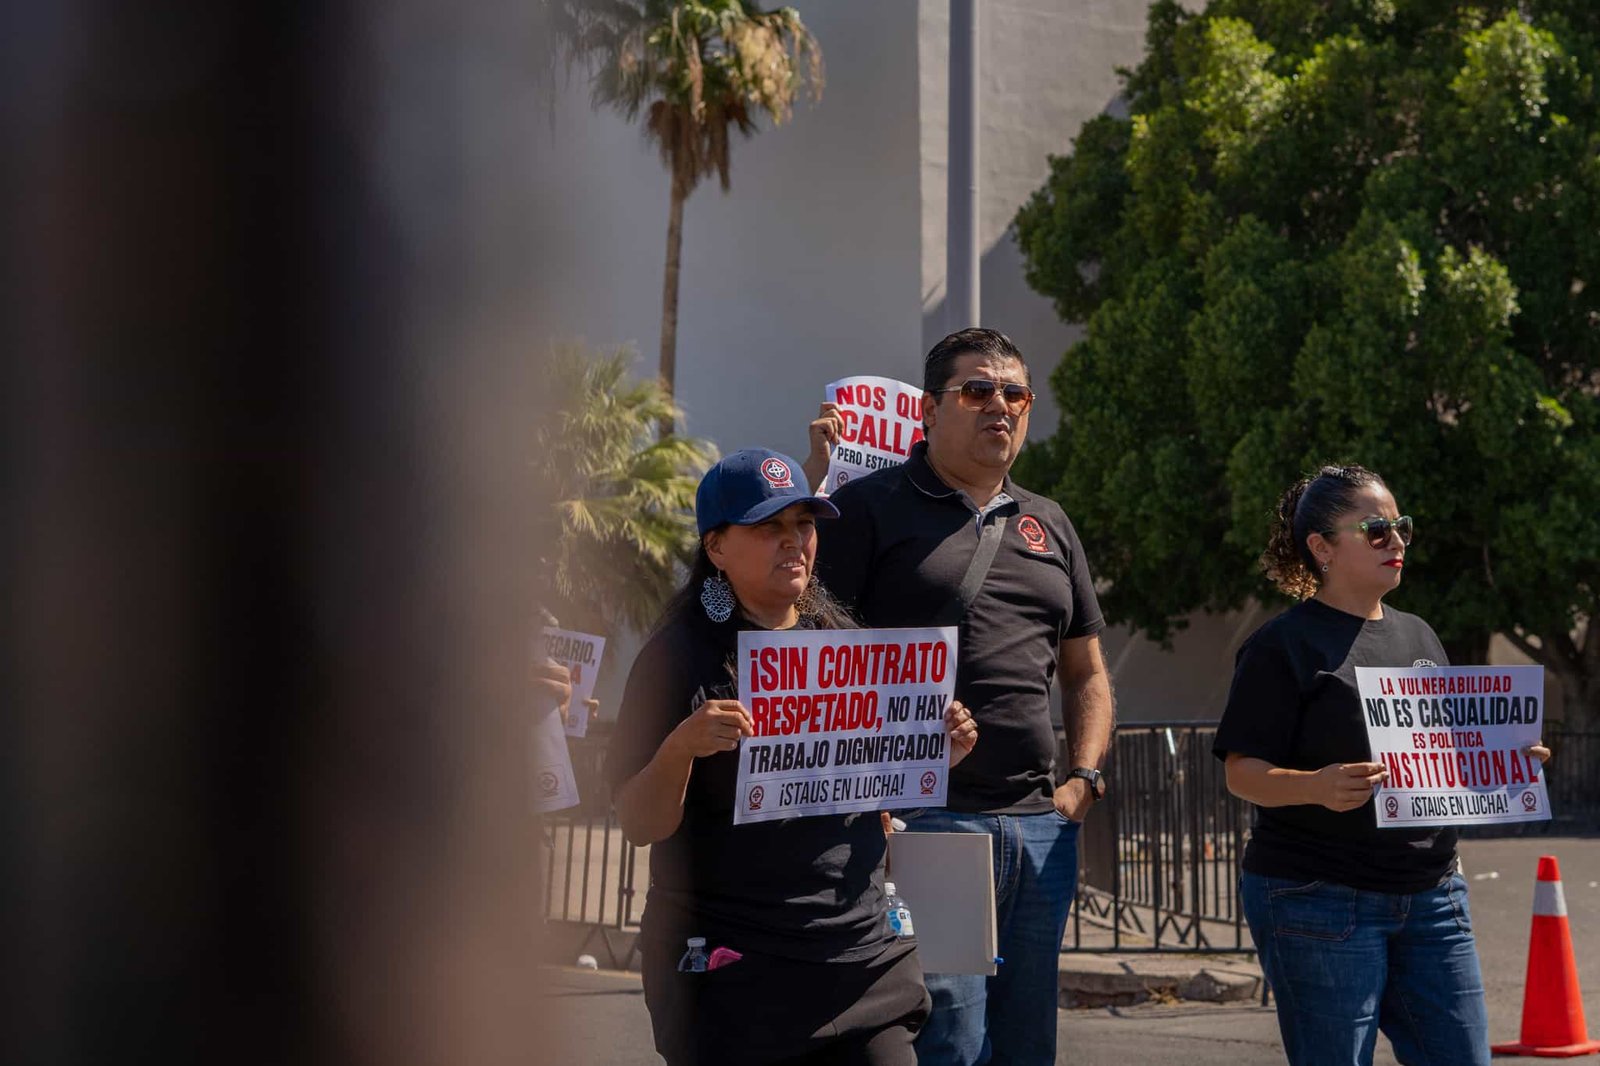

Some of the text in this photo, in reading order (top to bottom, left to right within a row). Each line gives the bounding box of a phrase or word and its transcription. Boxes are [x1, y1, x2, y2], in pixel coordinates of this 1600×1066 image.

[836, 384, 886, 412] NOS
[837, 446, 862, 466] PERO
[750, 641, 947, 693] ¡SIN CONTRATO
[1379, 675, 1512, 696] LA VULNERABILIDAD
[751, 690, 947, 737] RESPETADO, NO HAY
[1365, 696, 1538, 728] NO ES CASUALIDAD
[749, 732, 945, 774] TRABAJO DIGNIFICADO!
[1412, 728, 1484, 749] ES POLÍTICA
[1380, 749, 1539, 789] INSTITUCIONAL
[779, 773, 905, 806] ¡STAUS EN LUCHA!
[1411, 793, 1509, 817] ¡STAUS EN LUCHA!
